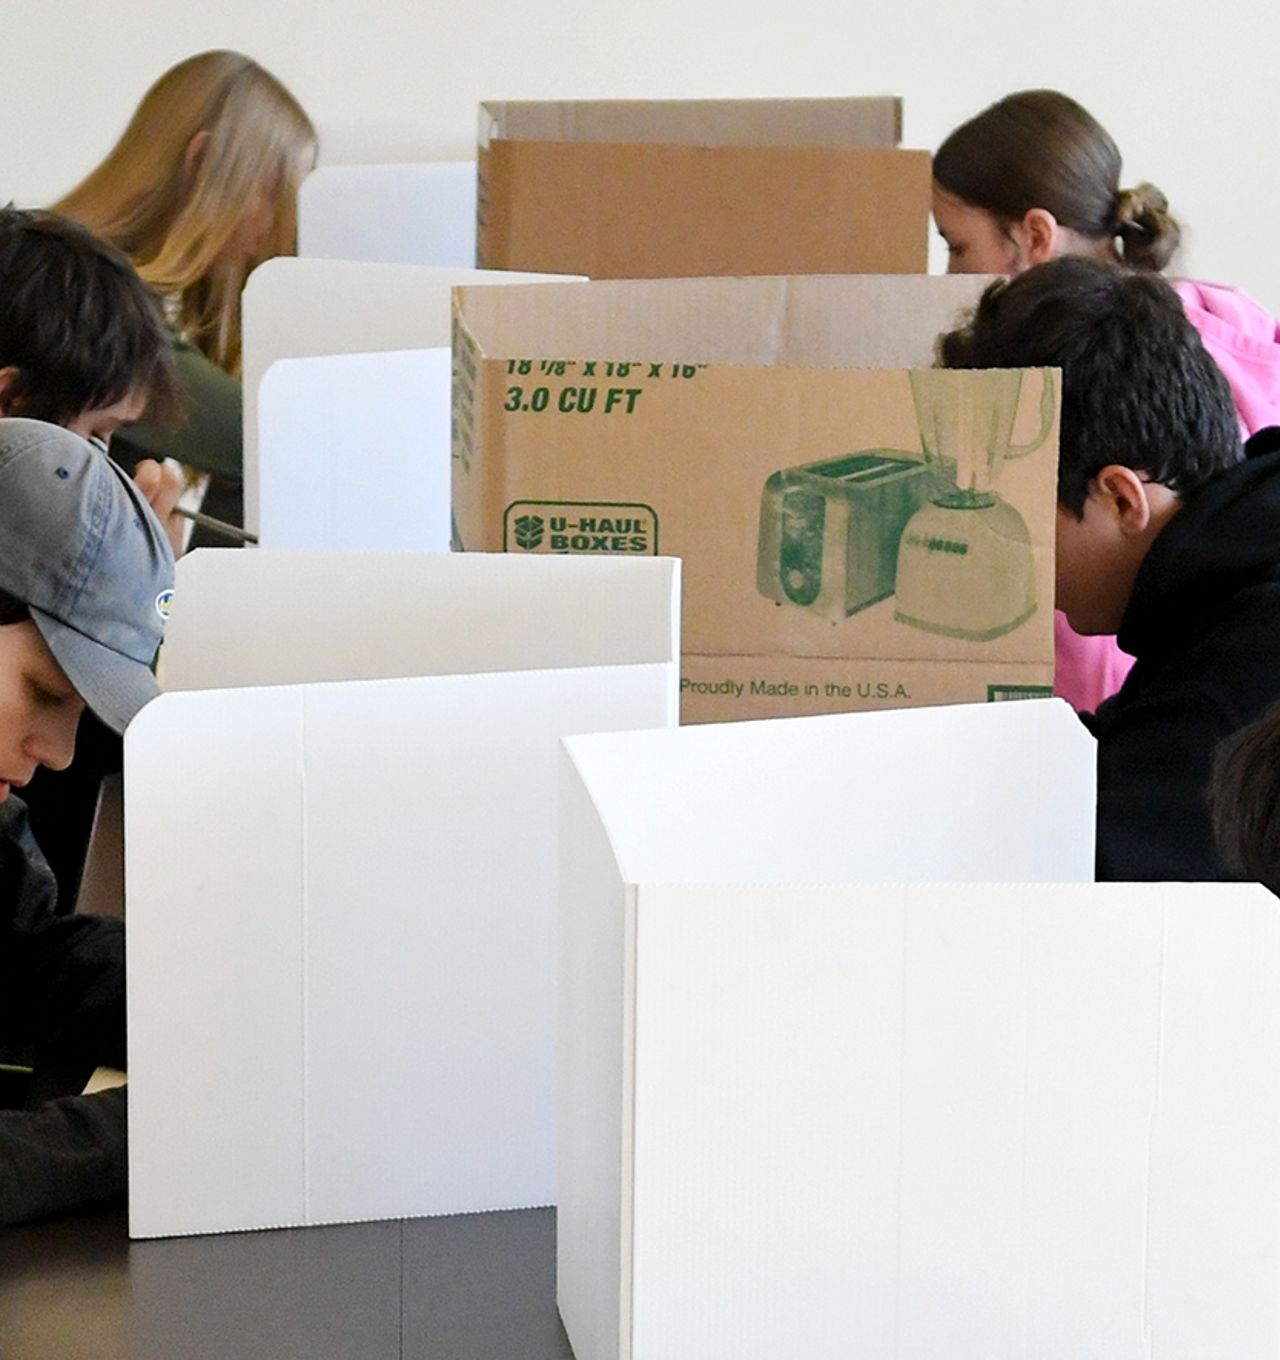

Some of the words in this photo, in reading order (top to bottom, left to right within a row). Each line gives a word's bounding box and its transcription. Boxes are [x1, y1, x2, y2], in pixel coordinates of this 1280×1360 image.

[507, 359, 532, 375] 18
[504, 387, 550, 412] 3.0
[558, 387, 597, 413] CU
[604, 388, 643, 414] FT
[550, 517, 647, 534] U-HAUL
[550, 534, 647, 552] BOXES
[679, 678, 744, 698] Proudly
[750, 681, 799, 696] Made
[804, 682, 818, 696] in
[825, 683, 851, 698] the
[857, 683, 912, 699] U.S.A.
